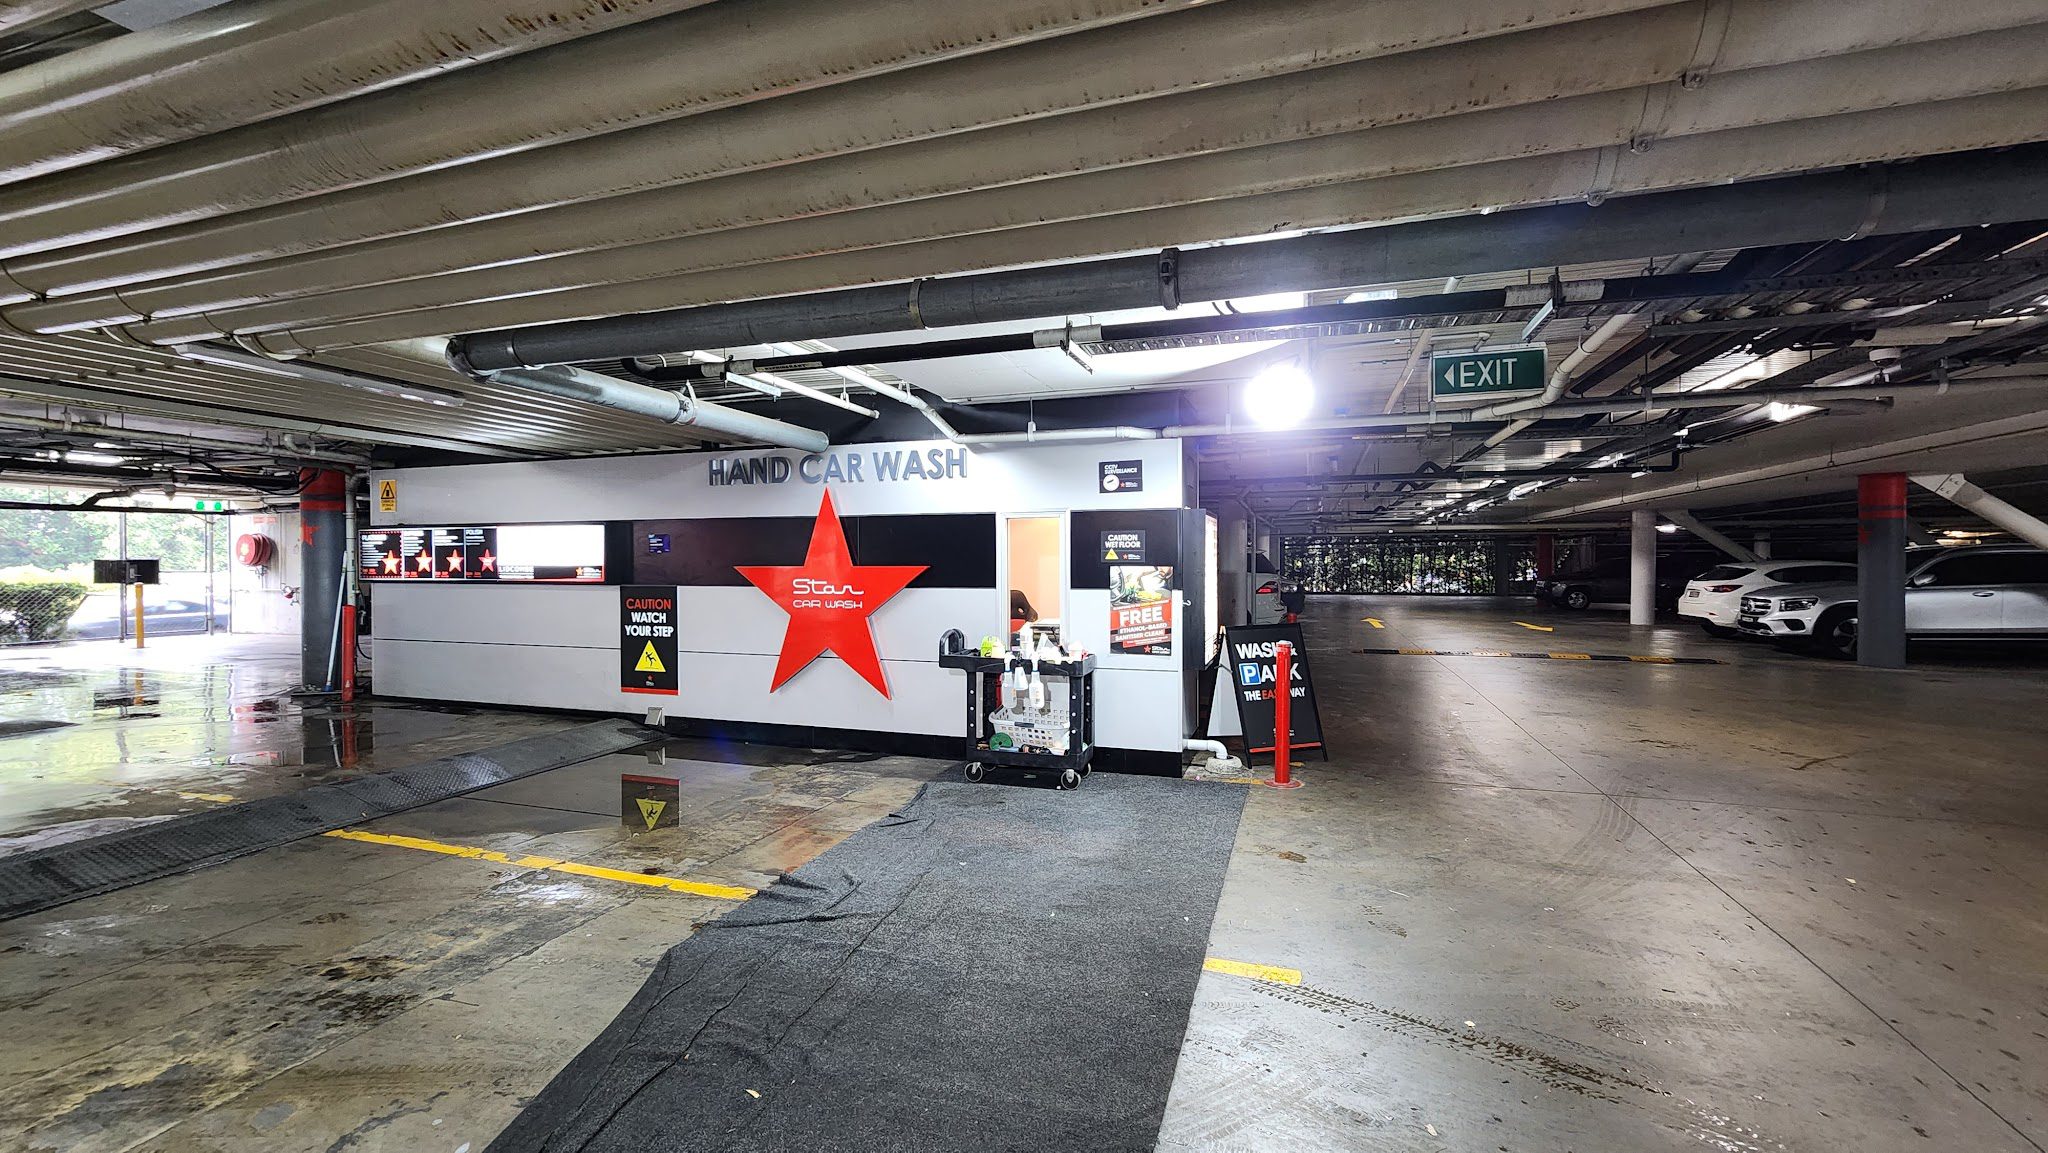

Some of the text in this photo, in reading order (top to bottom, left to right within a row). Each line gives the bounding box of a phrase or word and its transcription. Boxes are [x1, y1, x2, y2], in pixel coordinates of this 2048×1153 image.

[1460, 358, 1517, 387] EXIT
[709, 448, 967, 486] HAND CAR WASH
[793, 579, 864, 595] Star
[626, 598, 672, 610] CAUTION
[793, 600, 863, 609] CAR WASH
[631, 612, 667, 624] WATCH
[1119, 606, 1163, 628] FREE
[624, 625, 674, 638] YOUR STEP
[1240, 662, 1303, 685] PAK
[1244, 690, 1261, 701] THE
